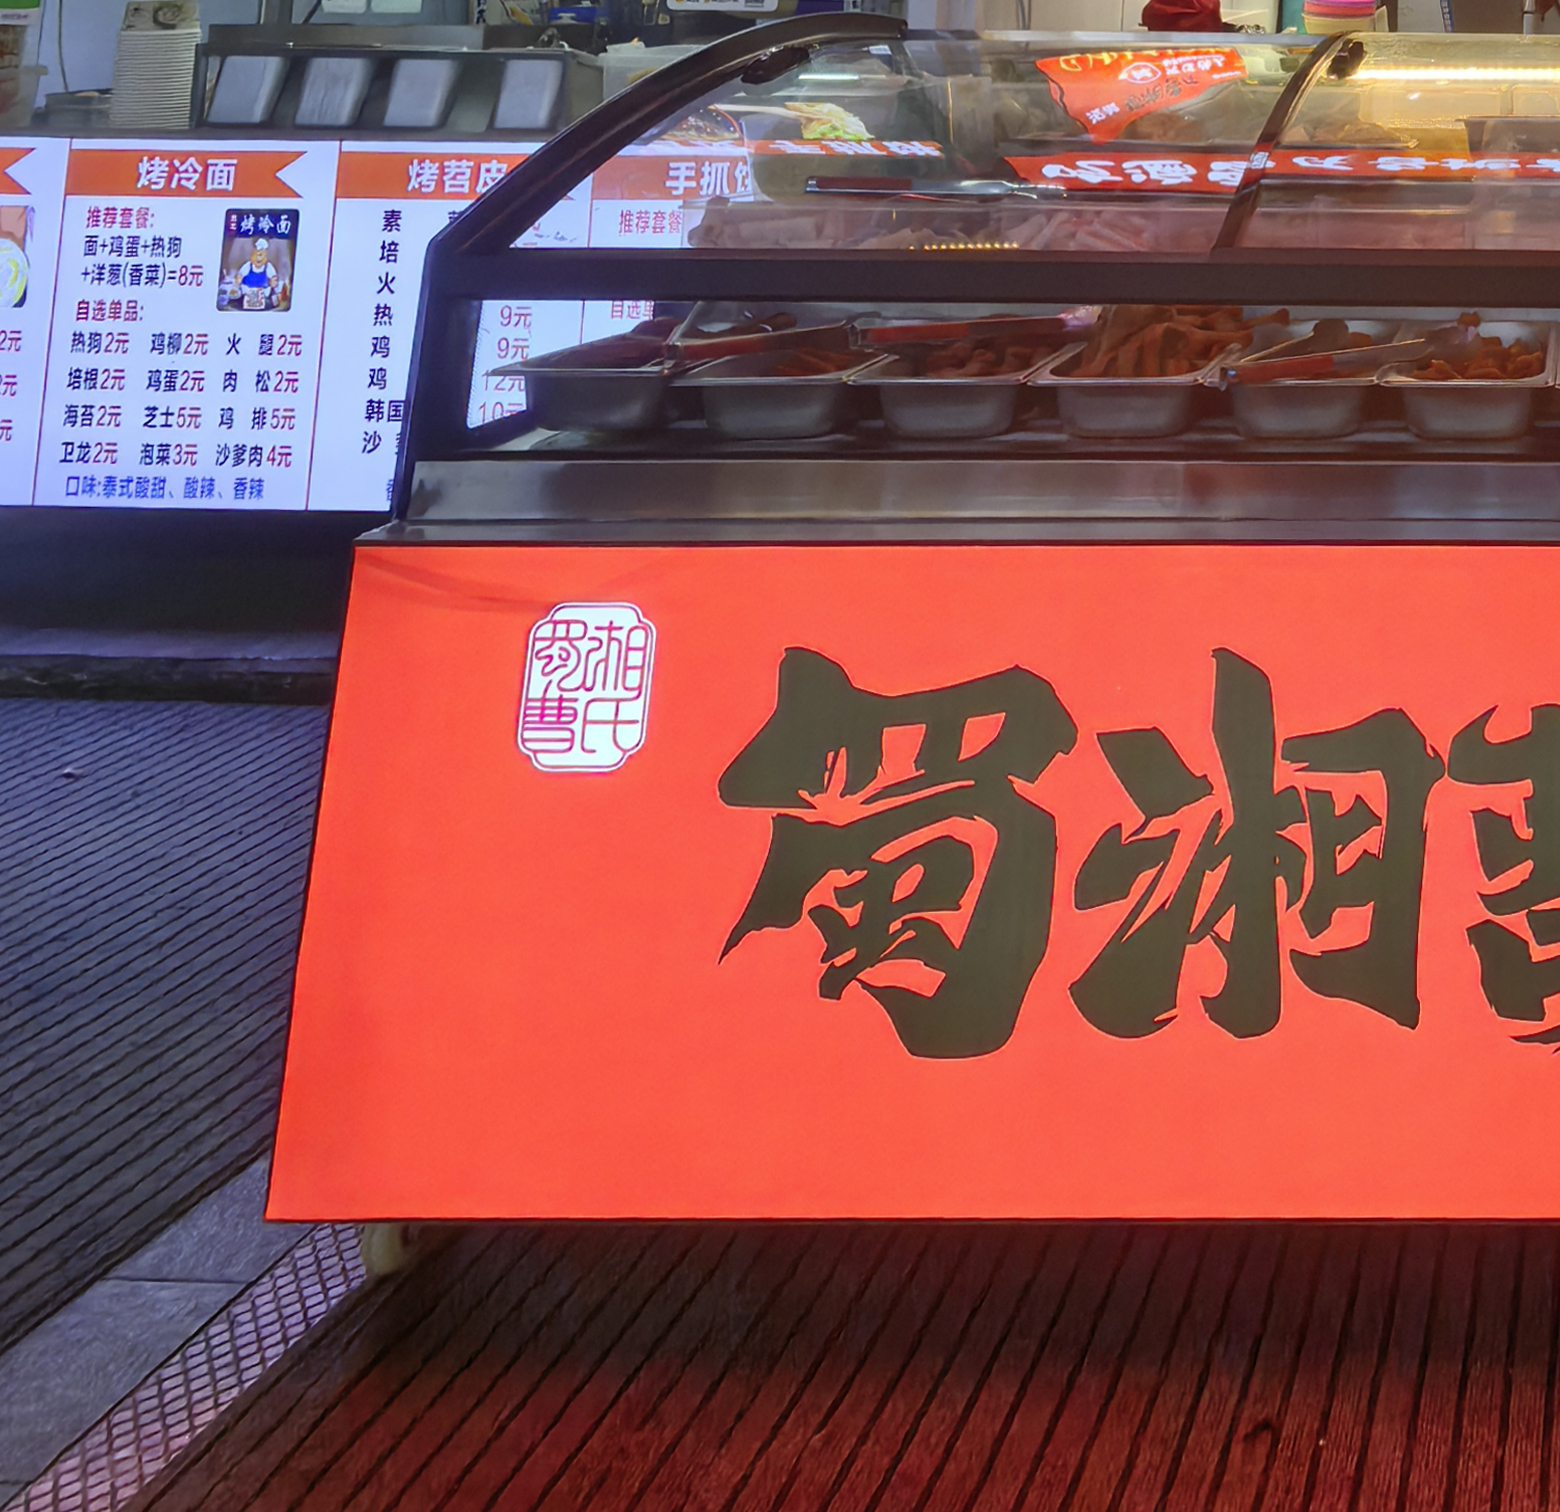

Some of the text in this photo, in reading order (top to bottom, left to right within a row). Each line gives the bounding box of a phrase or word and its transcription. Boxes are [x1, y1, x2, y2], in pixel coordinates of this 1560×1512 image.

[137, 156, 238, 191] 烤冷面
[70, 331, 130, 355] 热狗2元
[67, 367, 126, 391] 培根2元
[146, 368, 205, 393] 鸡蛋2元
[62, 404, 122, 429] 海苔2元
[142, 405, 202, 430] 芝士5元
[59, 440, 118, 466] 卫龙2元
[139, 442, 198, 467] 泡菜3元
